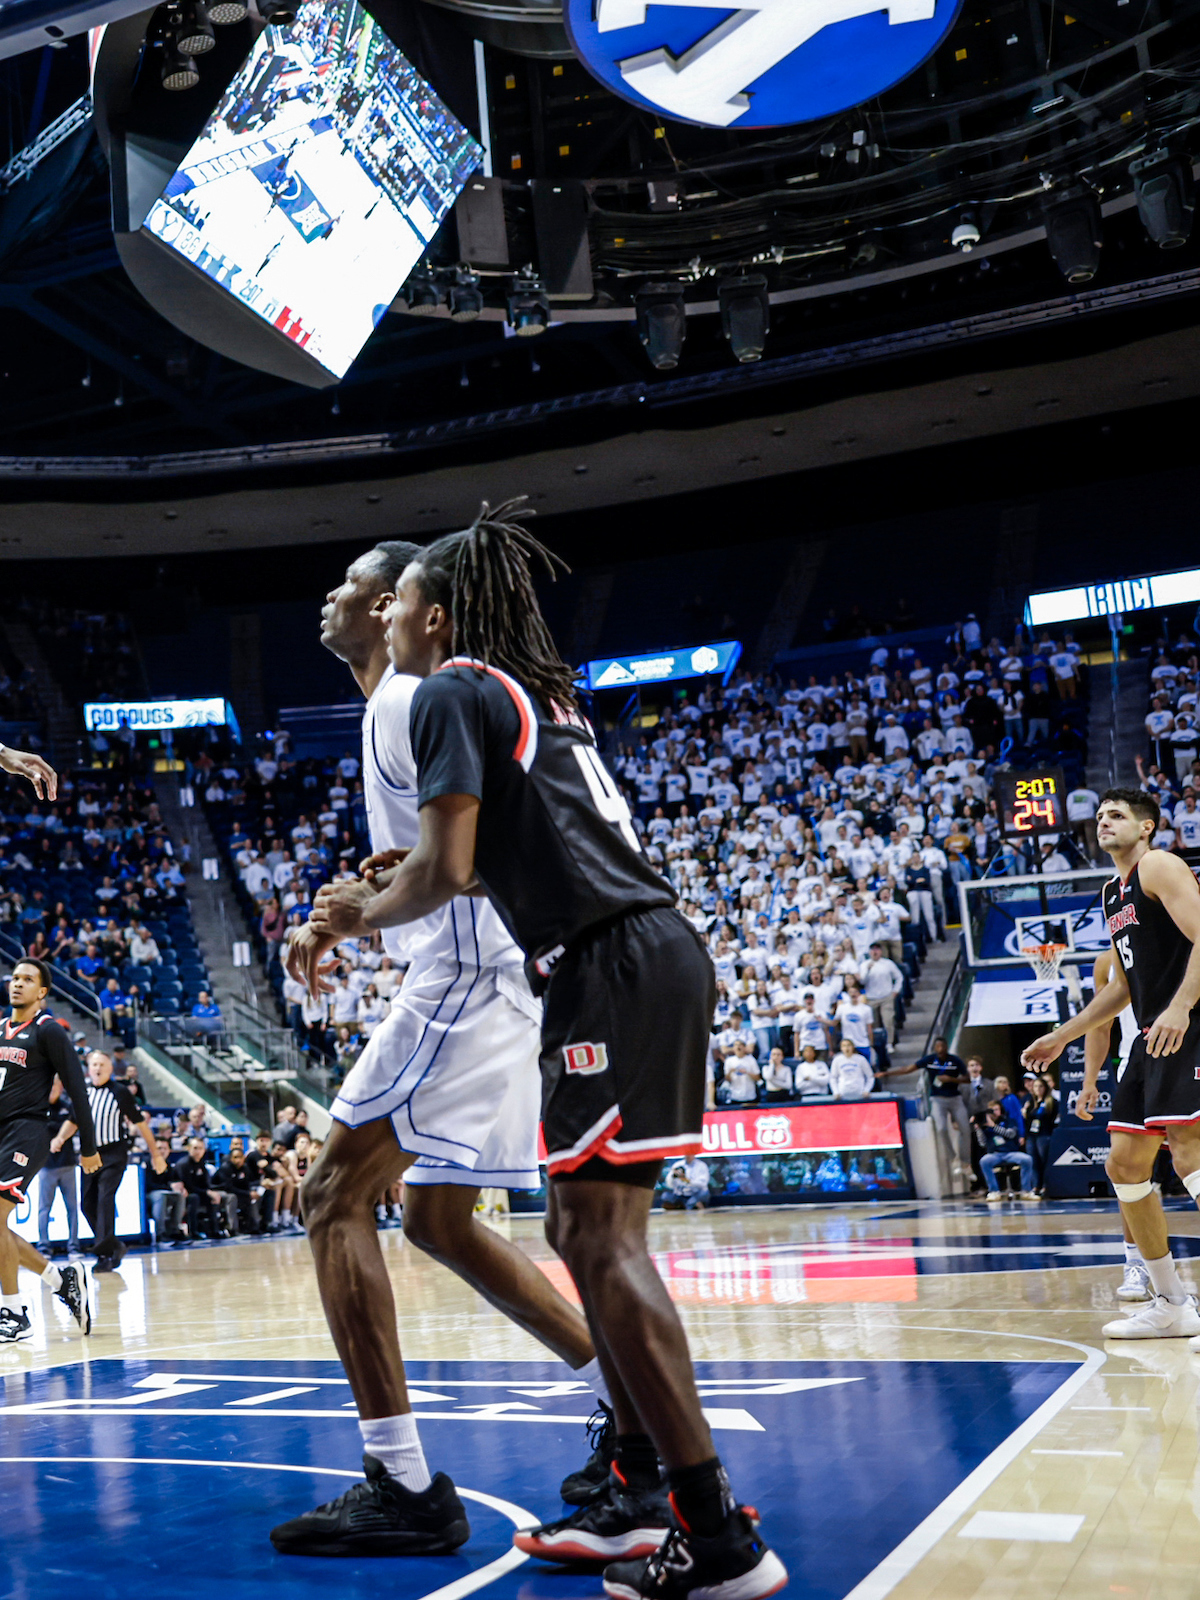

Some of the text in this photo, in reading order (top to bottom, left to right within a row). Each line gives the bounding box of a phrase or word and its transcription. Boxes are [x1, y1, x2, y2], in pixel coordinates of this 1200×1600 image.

[1015, 777, 1056, 799] 2:07
[1013, 799, 1056, 831] 24
[562, 1041, 609, 1075] DU
[702, 1122, 753, 1151] ULL
